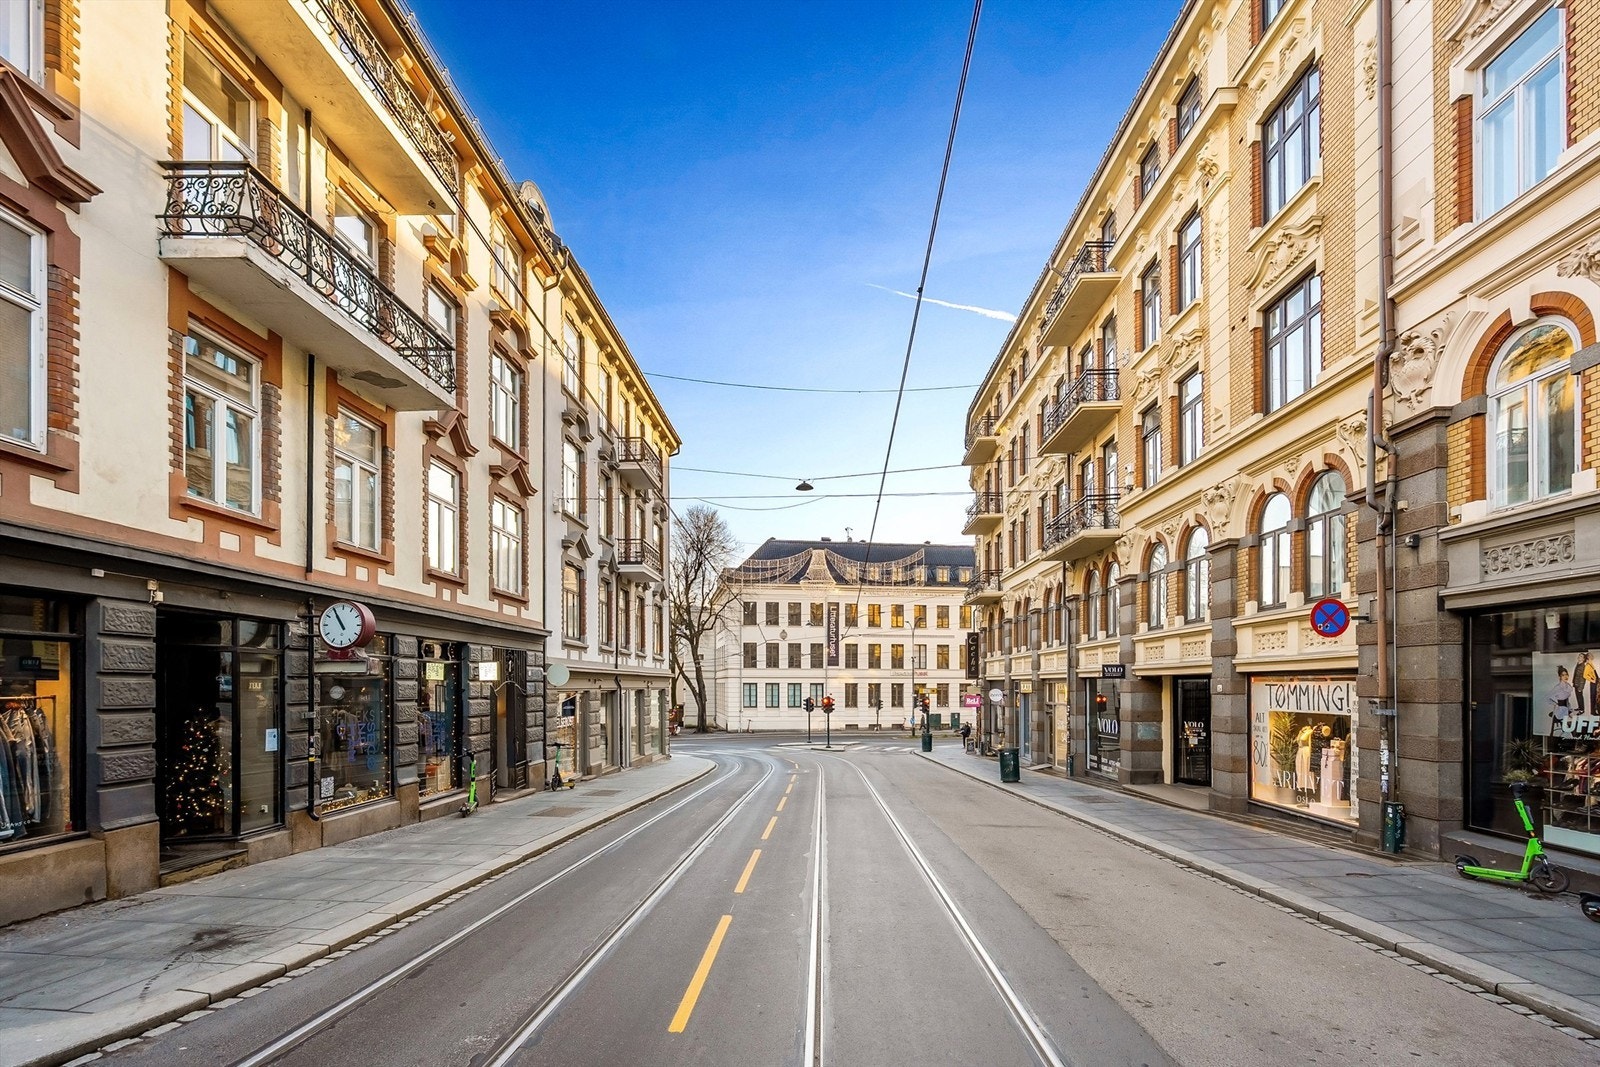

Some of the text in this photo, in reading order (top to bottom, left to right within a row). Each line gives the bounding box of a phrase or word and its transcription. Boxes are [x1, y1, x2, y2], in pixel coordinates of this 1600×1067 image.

[968, 635, 977, 672] Cochs
[1265, 683, 1351, 713] TØMMING!
[1097, 718, 1118, 734] VOLO
[1560, 715, 1600, 733] UFF
[1273, 770, 1344, 800] ARKIVT
